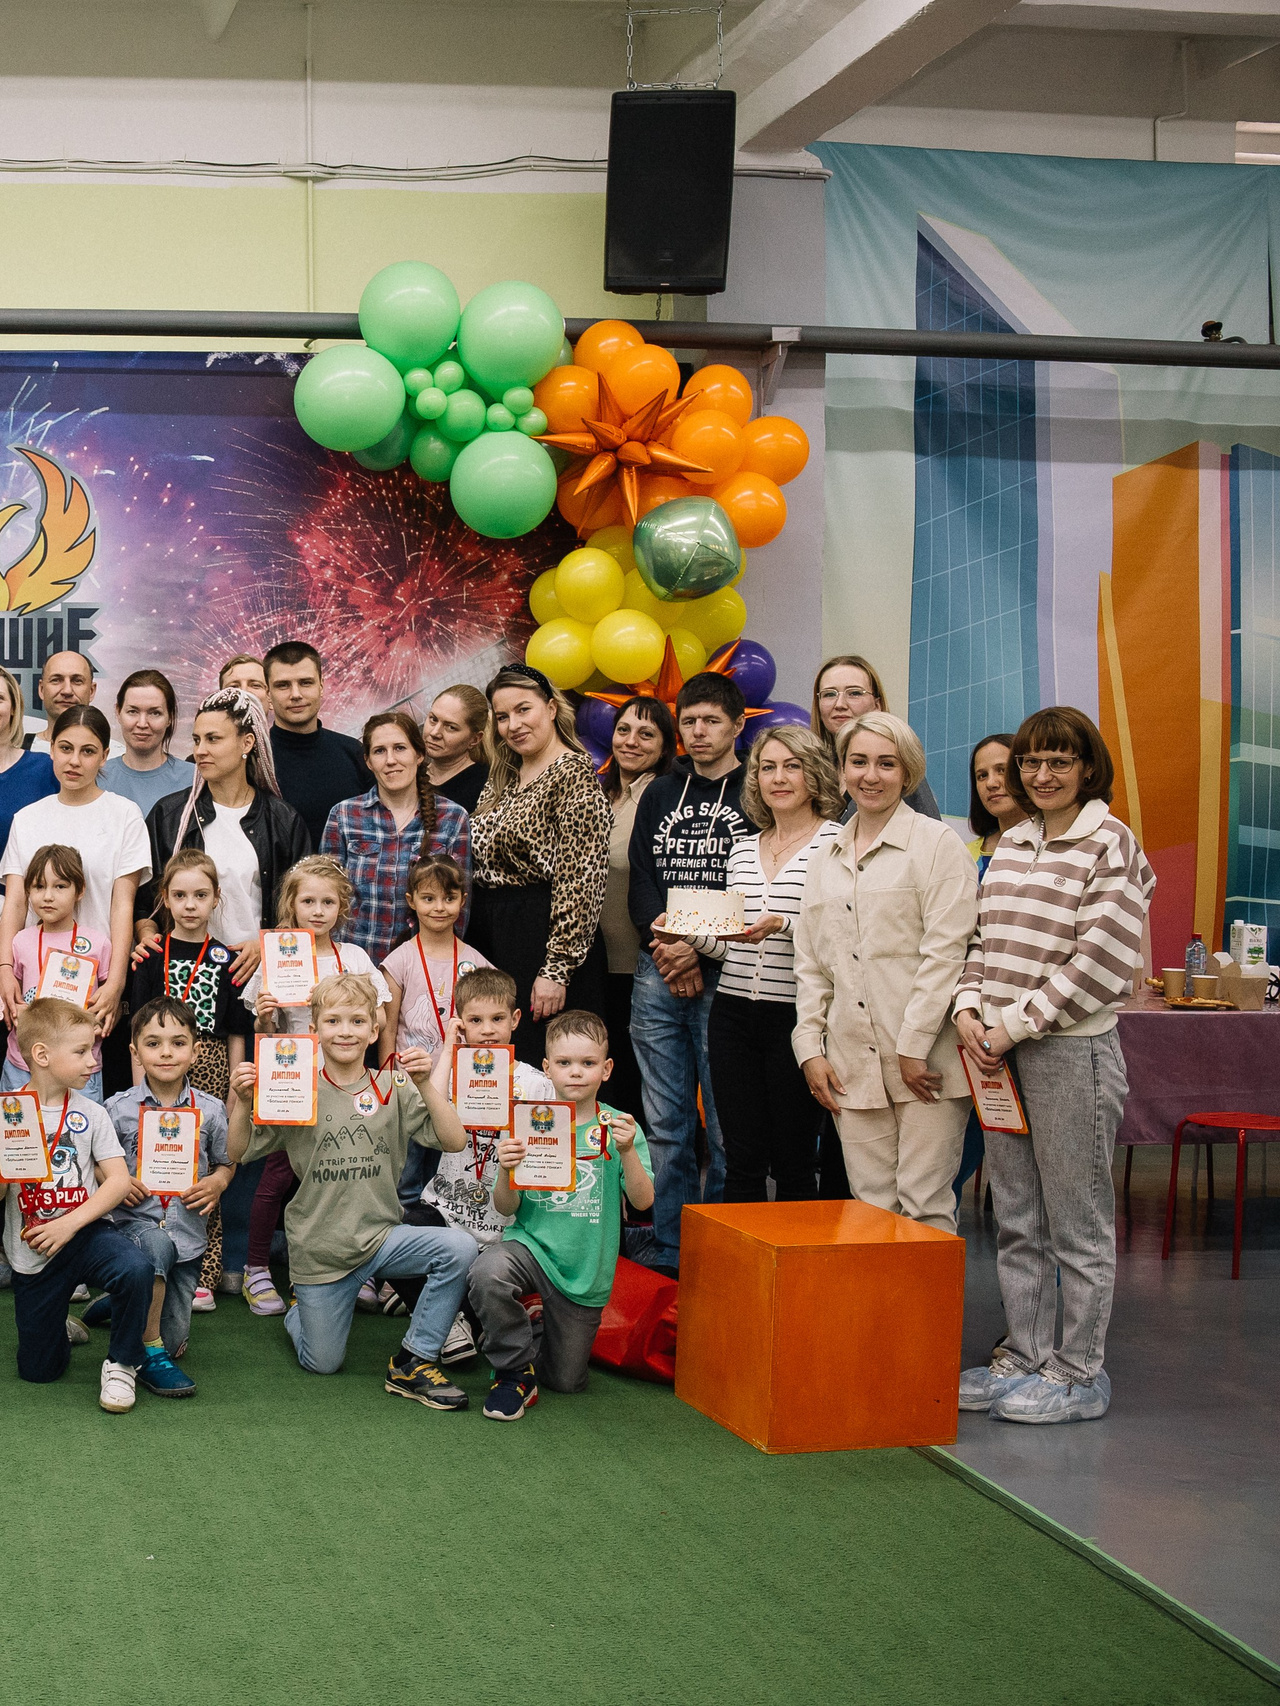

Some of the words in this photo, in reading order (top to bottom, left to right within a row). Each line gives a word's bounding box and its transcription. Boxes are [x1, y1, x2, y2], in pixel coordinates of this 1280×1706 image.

[670, 858, 707, 868] PREMIER
[663, 871, 677, 881] F/T
[678, 871, 700, 881] HALF
[701, 871, 724, 882] MILE
[276, 960, 303, 969] ДИПЛОМ
[271, 1071, 300, 1080] ДИПЛОМ
[469, 1080, 498, 1089] ДИПЛОМ
[4, 1129, 31, 1140] ДИПЛОМ
[528, 1136, 559, 1146] ДИПЛОМ
[154, 1143, 183, 1153] ДИПЛОМ
[319, 1159, 324, 1167] A
[349, 1156, 359, 1164] TO
[361, 1155, 374, 1163] THE
[56, 1190, 86, 1205] PLAY
